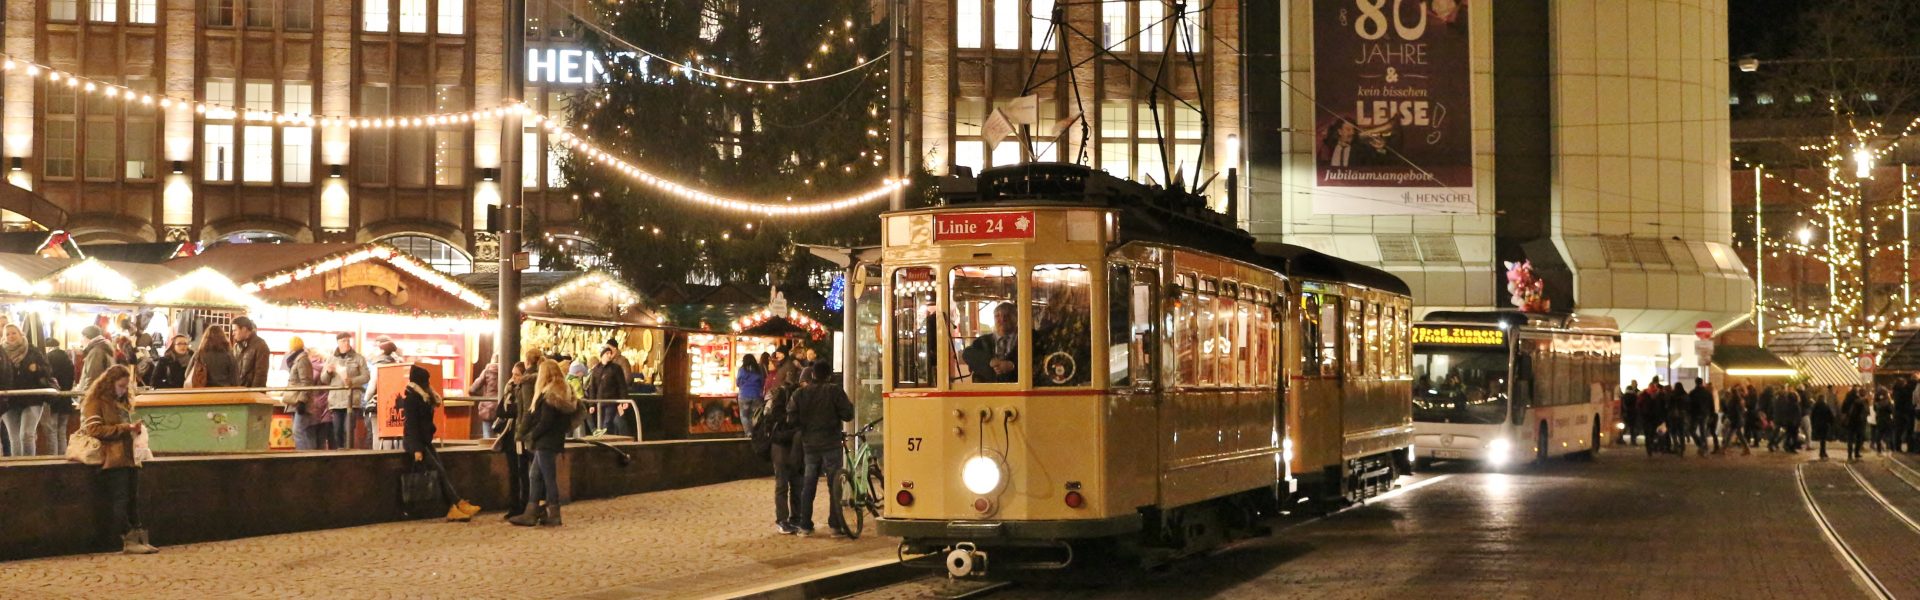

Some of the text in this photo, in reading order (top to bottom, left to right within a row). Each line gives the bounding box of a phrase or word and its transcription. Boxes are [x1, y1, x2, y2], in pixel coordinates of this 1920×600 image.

[1355, 0, 1427, 40] 80
[1355, 44, 1428, 64] JAHRE
[1385, 66, 1399, 83] &
[1358, 86, 1428, 97] kein bisschen
[1324, 169, 1435, 184] Jubiläumsangebote
[1416, 193, 1471, 203] HENSCHEL
[938, 219, 1004, 234] Linie 24
[907, 437, 922, 452] 57
